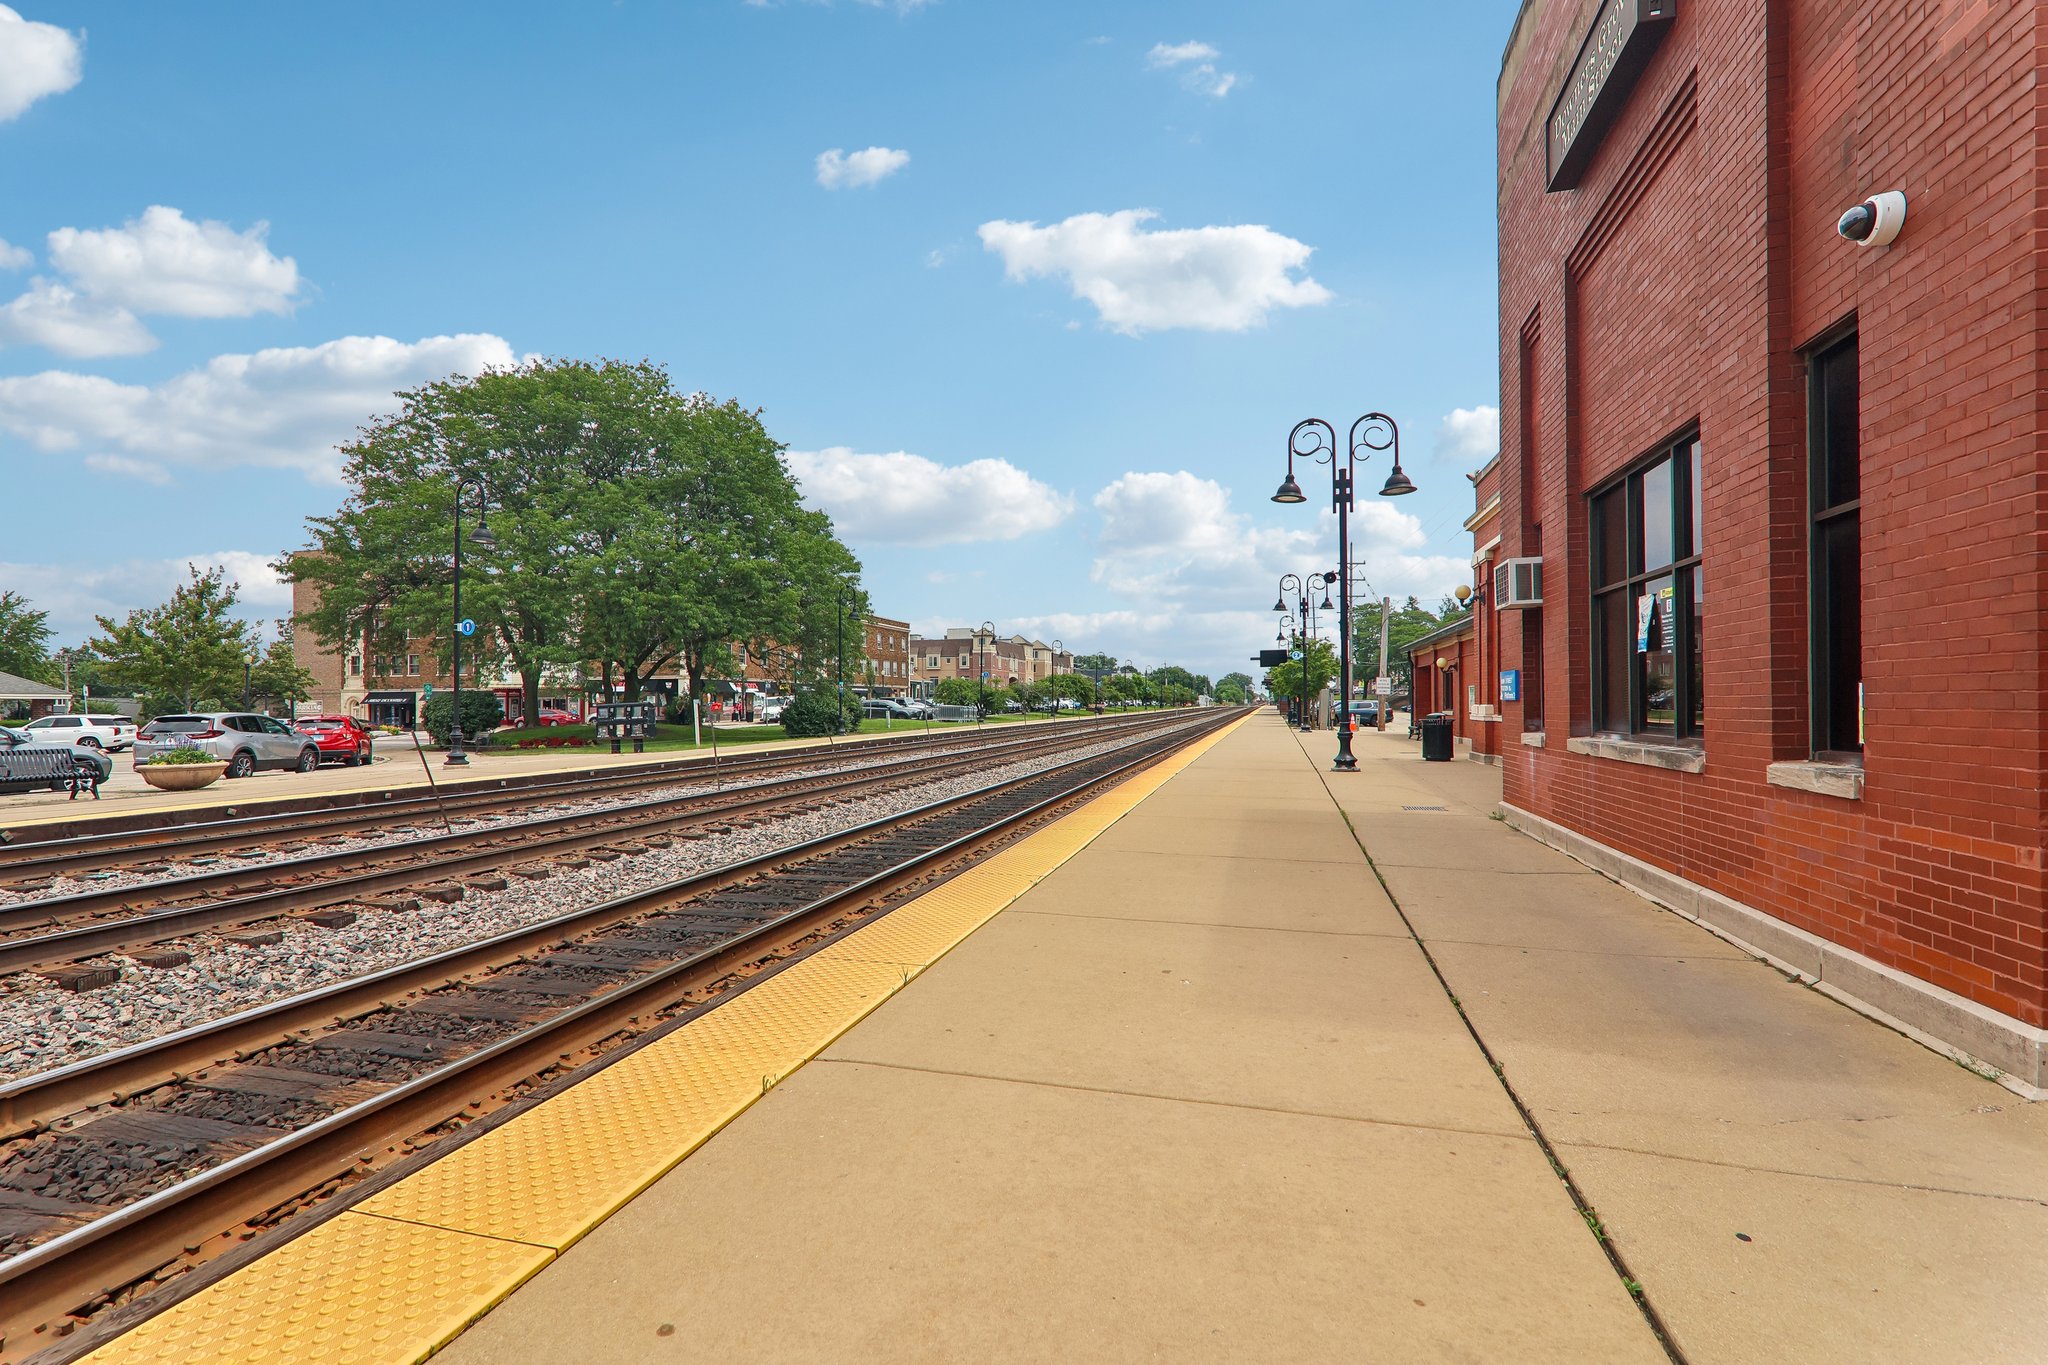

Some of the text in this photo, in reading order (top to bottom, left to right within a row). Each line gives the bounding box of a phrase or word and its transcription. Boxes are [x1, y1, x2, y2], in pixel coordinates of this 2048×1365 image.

[1554, 50, 1596, 141] Downers
[1561, 26, 1623, 155] Main Street
